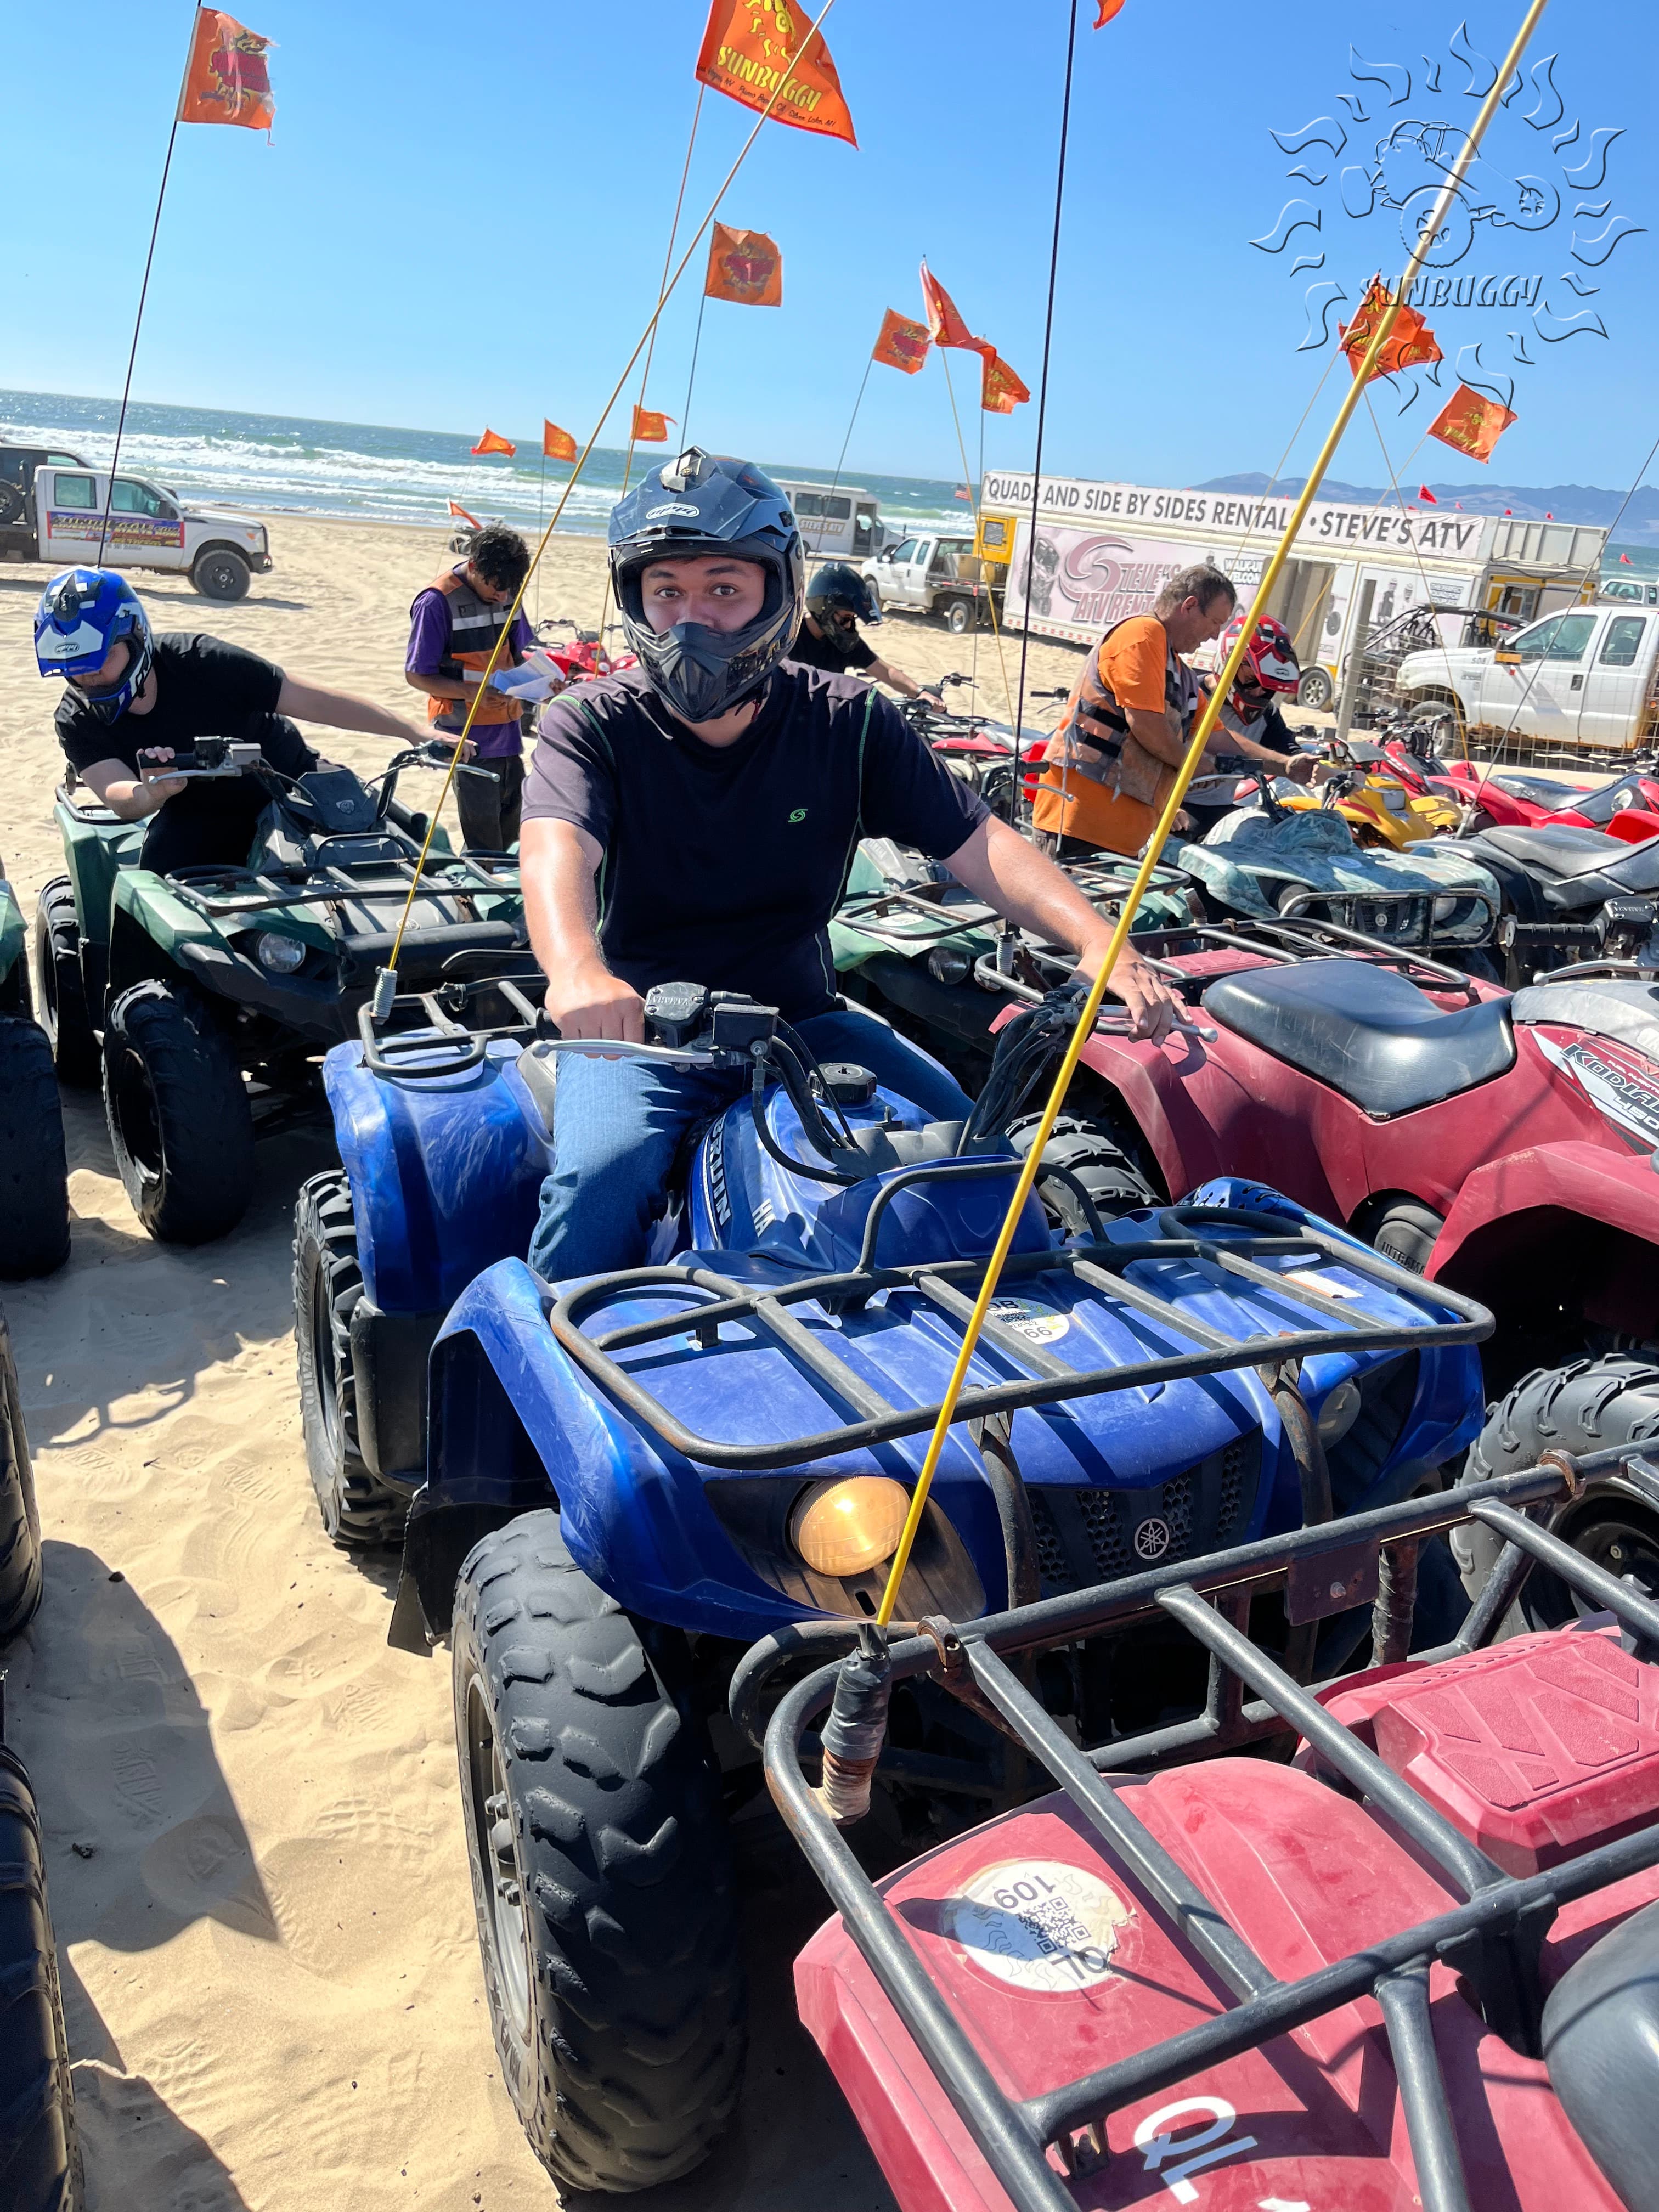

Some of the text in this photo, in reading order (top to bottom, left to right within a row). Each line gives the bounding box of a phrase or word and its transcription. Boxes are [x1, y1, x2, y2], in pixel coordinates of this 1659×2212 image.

[716, 46, 822, 112] SUNBUGGY
[1043, 485, 1079, 507] AND
[1084, 488, 1122, 512] SIDE
[1126, 493, 1151, 516] BY
[1153, 495, 1207, 522] SIDES
[1211, 501, 1296, 531] RENTAL
[1319, 511, 1413, 545] STEVE'S
[1418, 521, 1475, 549] ATV
[1073, 591, 1109, 622] ATV
[1560, 1042, 1659, 1114] KODIA
[1607, 1059, 1627, 1074] FUEL
[1613, 1096, 1659, 1131] 450
[710, 1112, 732, 1226] BRUIN
[994, 1875, 1056, 1909] 109
[1051, 1946, 1108, 1980] QL
[1133, 2096, 1258, 2205] QL
